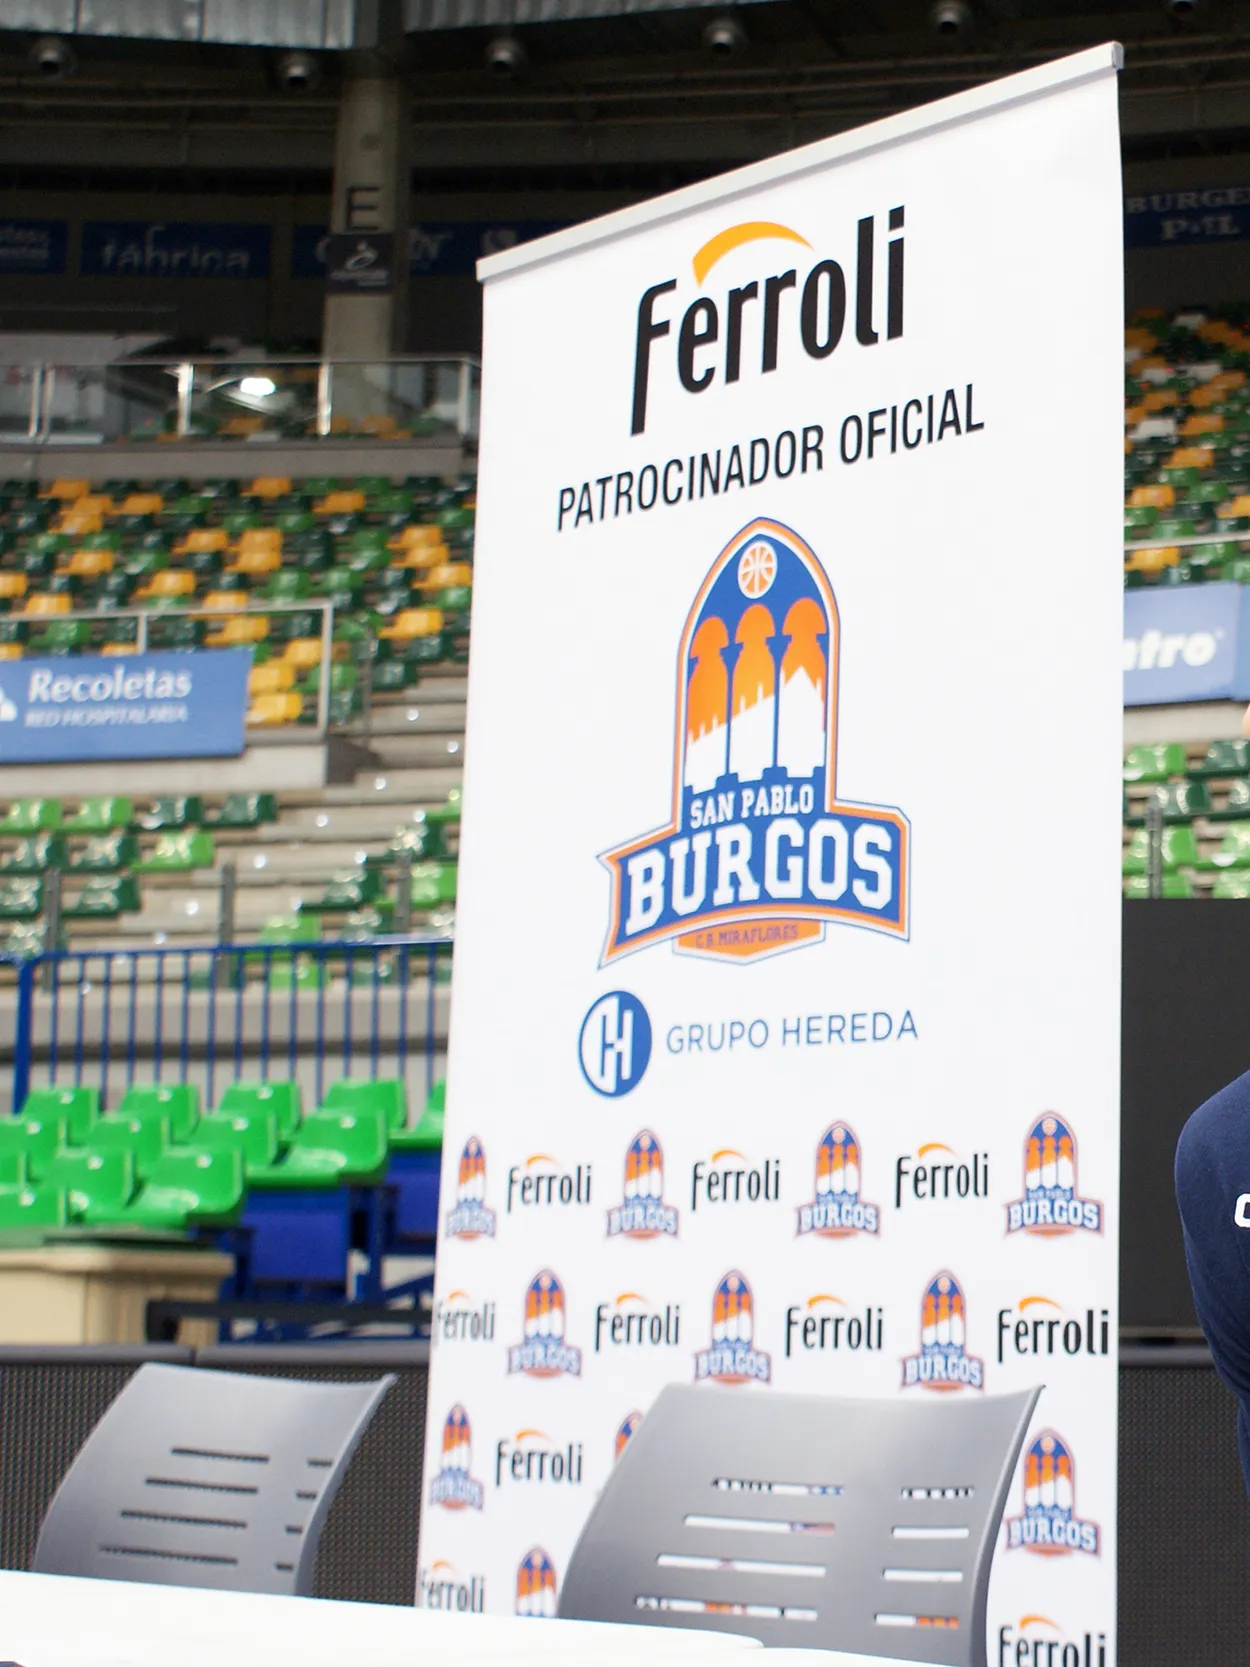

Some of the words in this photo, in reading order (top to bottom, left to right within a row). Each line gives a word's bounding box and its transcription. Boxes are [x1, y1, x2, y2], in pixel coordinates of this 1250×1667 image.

[347, 186, 380, 231] E
[631, 205, 905, 437] Ferroli
[557, 425, 823, 532] PATROCINADOR
[840, 383, 985, 465] OFICIAL
[28, 664, 192, 703] Recoletas
[690, 791, 734, 829] SAN
[741, 783, 815, 819] PABLO
[625, 817, 893, 937] BURGOS
[718, 924, 798, 946] MIRAFLORES
[667, 1018, 769, 1054] GRUPO
[783, 1009, 918, 1046] HEREDA
[507, 1165, 592, 1214] Ferroli
[692, 1160, 780, 1212] Ferroli
[895, 1152, 989, 1210] Ferroli
[800, 1202, 877, 1232] BURGOS
[1009, 1199, 1099, 1230] BURGOS
[595, 1304, 680, 1353] Ferroli
[786, 1307, 883, 1358] Ferroli
[998, 1309, 1109, 1364] Ferroli
[906, 1354, 981, 1387] BURGOS
[495, 1440, 583, 1487] Ferroli
[1010, 1518, 1096, 1552] BURGOS
[1000, 1626, 1106, 1667] Ferroli
